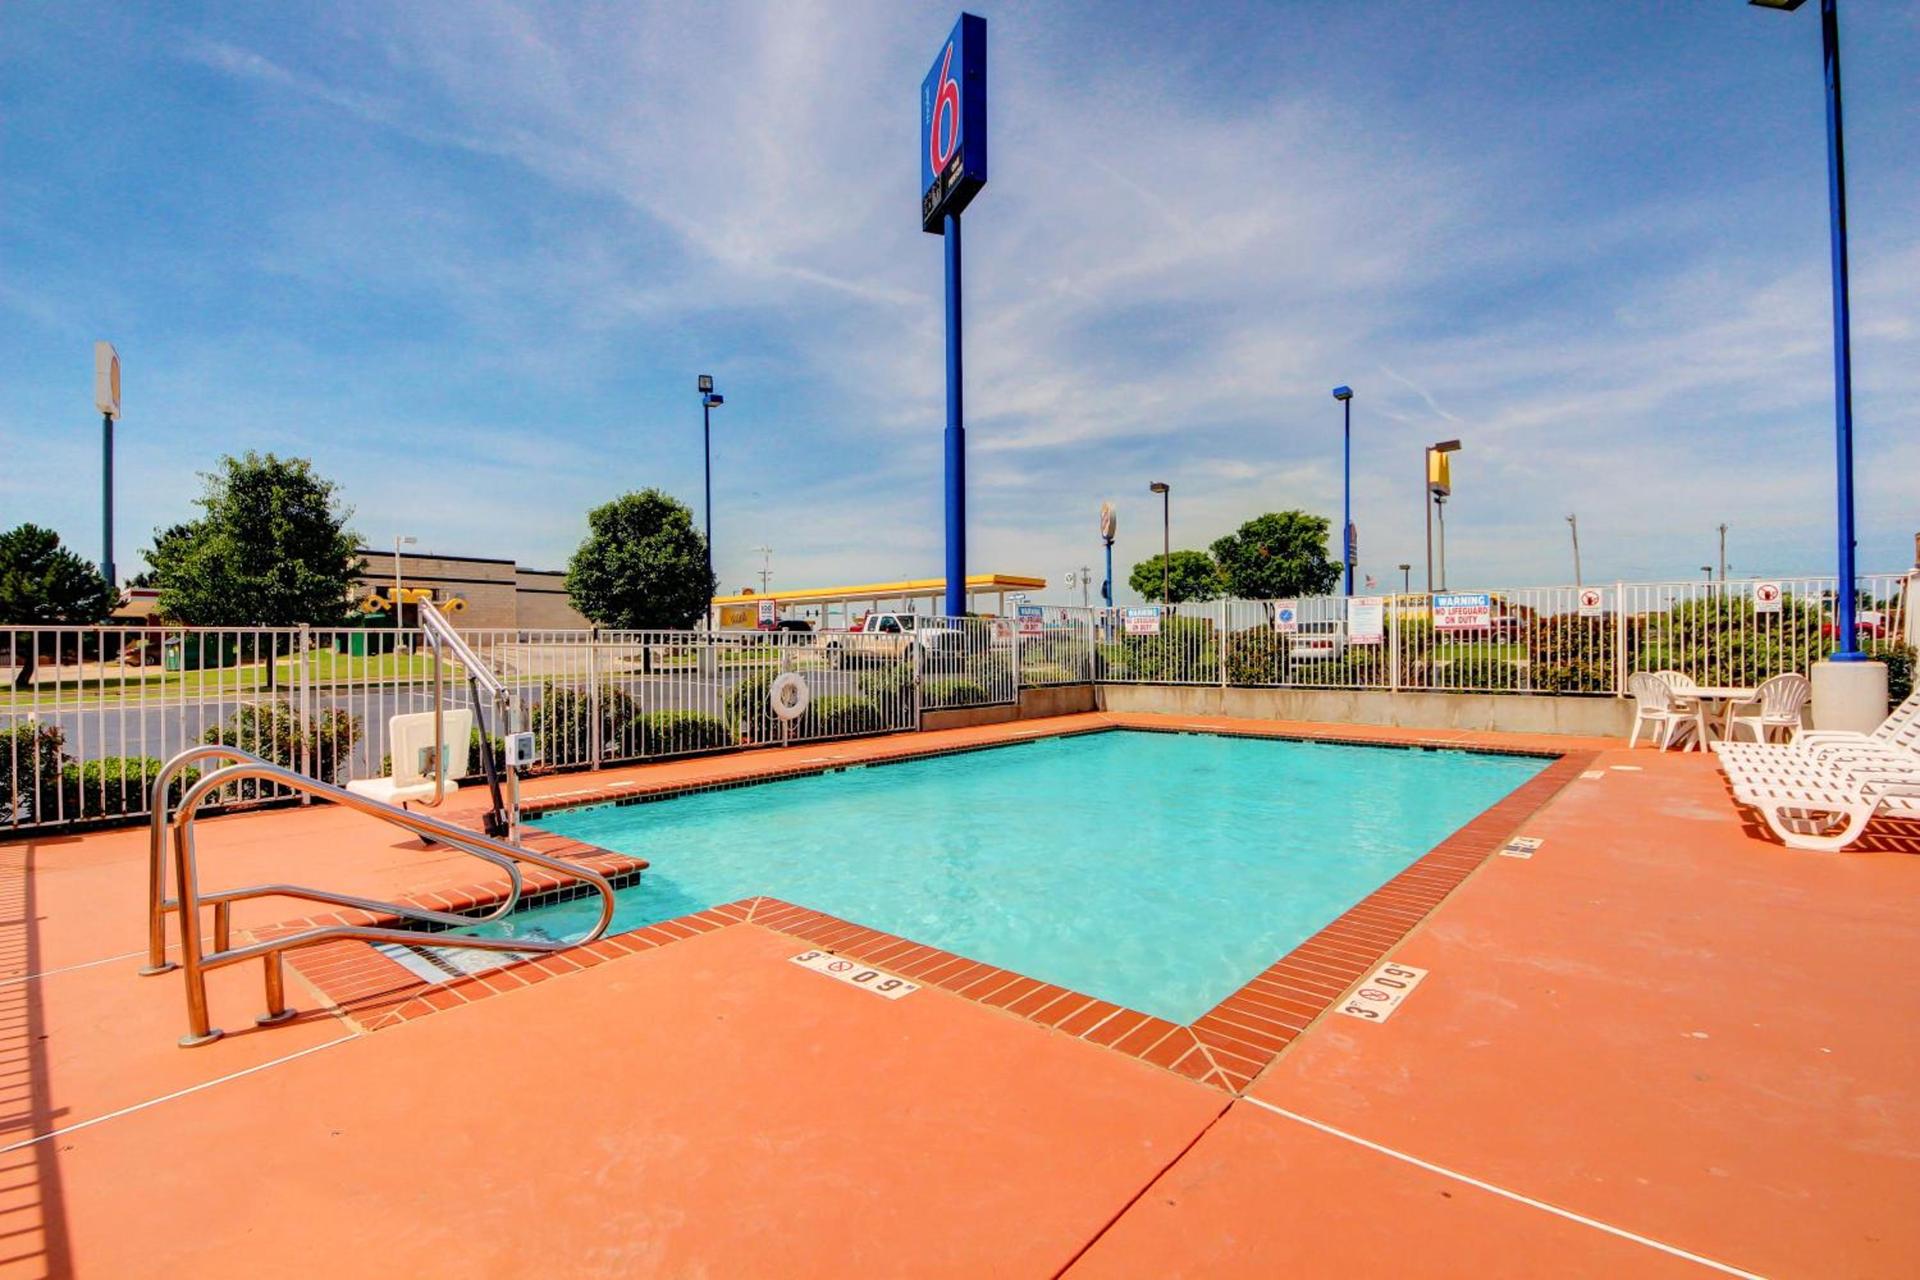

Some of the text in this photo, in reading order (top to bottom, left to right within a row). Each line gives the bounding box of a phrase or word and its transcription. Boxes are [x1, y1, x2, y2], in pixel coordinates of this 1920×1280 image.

[930, 41, 960, 178] 6
[1438, 596, 1485, 607] WARNING
[1435, 606, 1488, 615] NO LIFEGUARD
[1445, 616, 1478, 624] ON DUTY
[796, 951, 822, 963] 3
[1344, 1006, 1379, 1018] 3
